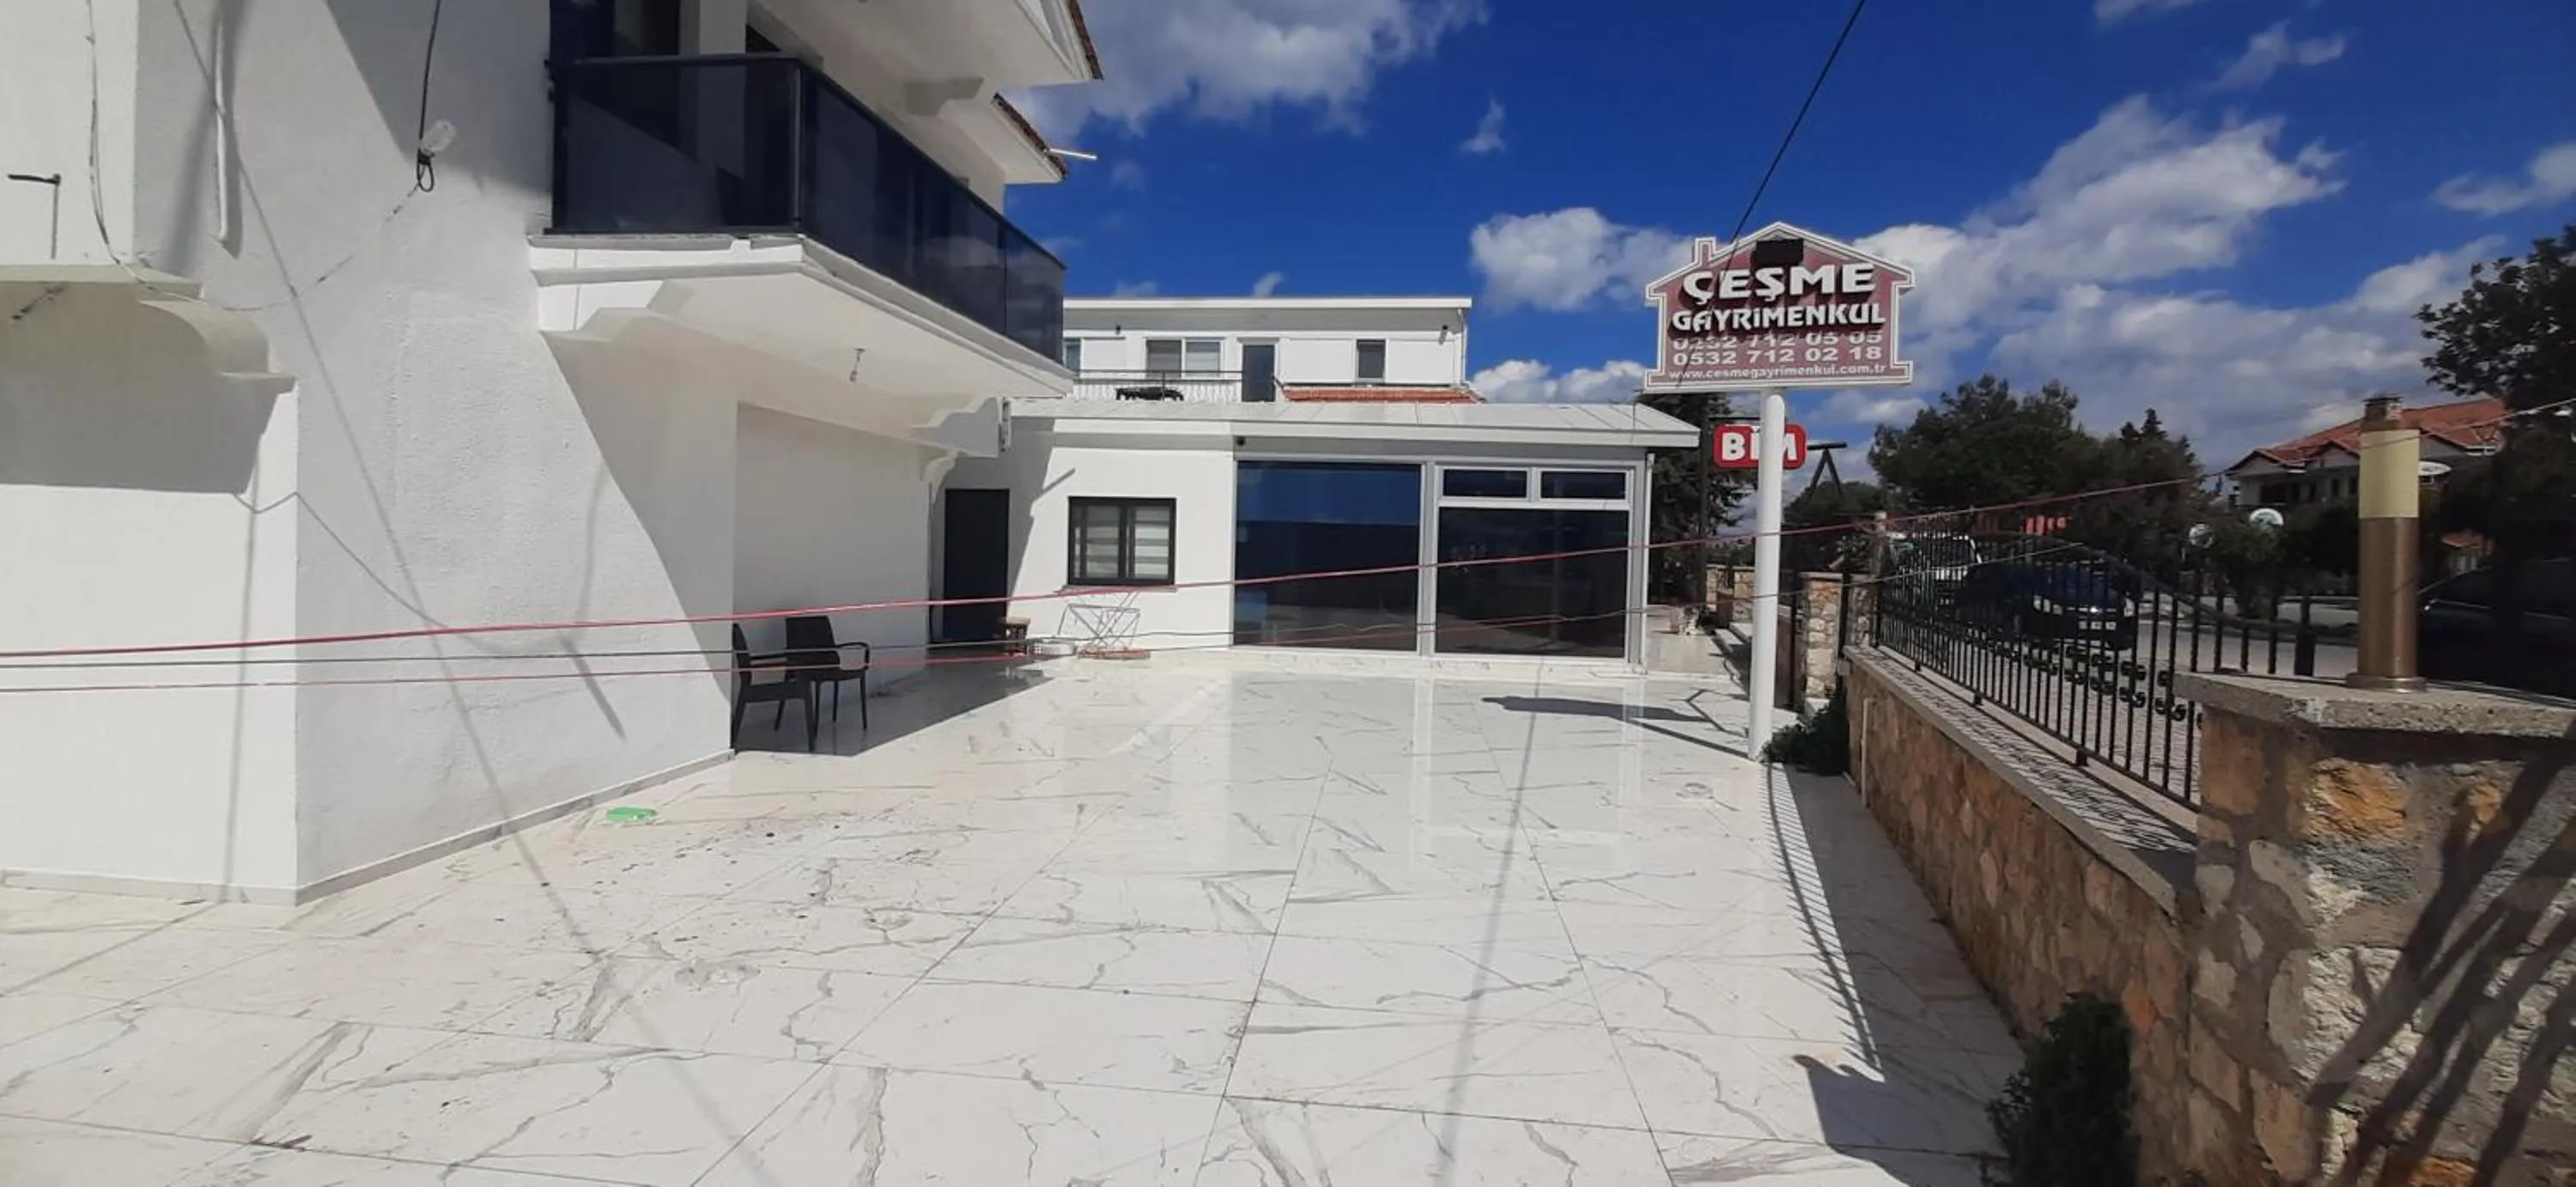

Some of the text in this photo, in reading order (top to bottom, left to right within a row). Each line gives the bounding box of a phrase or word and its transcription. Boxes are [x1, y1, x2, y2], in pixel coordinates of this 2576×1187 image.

[1682, 263, 1877, 306] ÇEŞME
[1673, 329, 1882, 350] 0232 712 05 05
[1673, 345, 1882, 366] 0532 712 02 18
[1668, 363, 1886, 380] www.cesmegayrimenkul.com.tr
